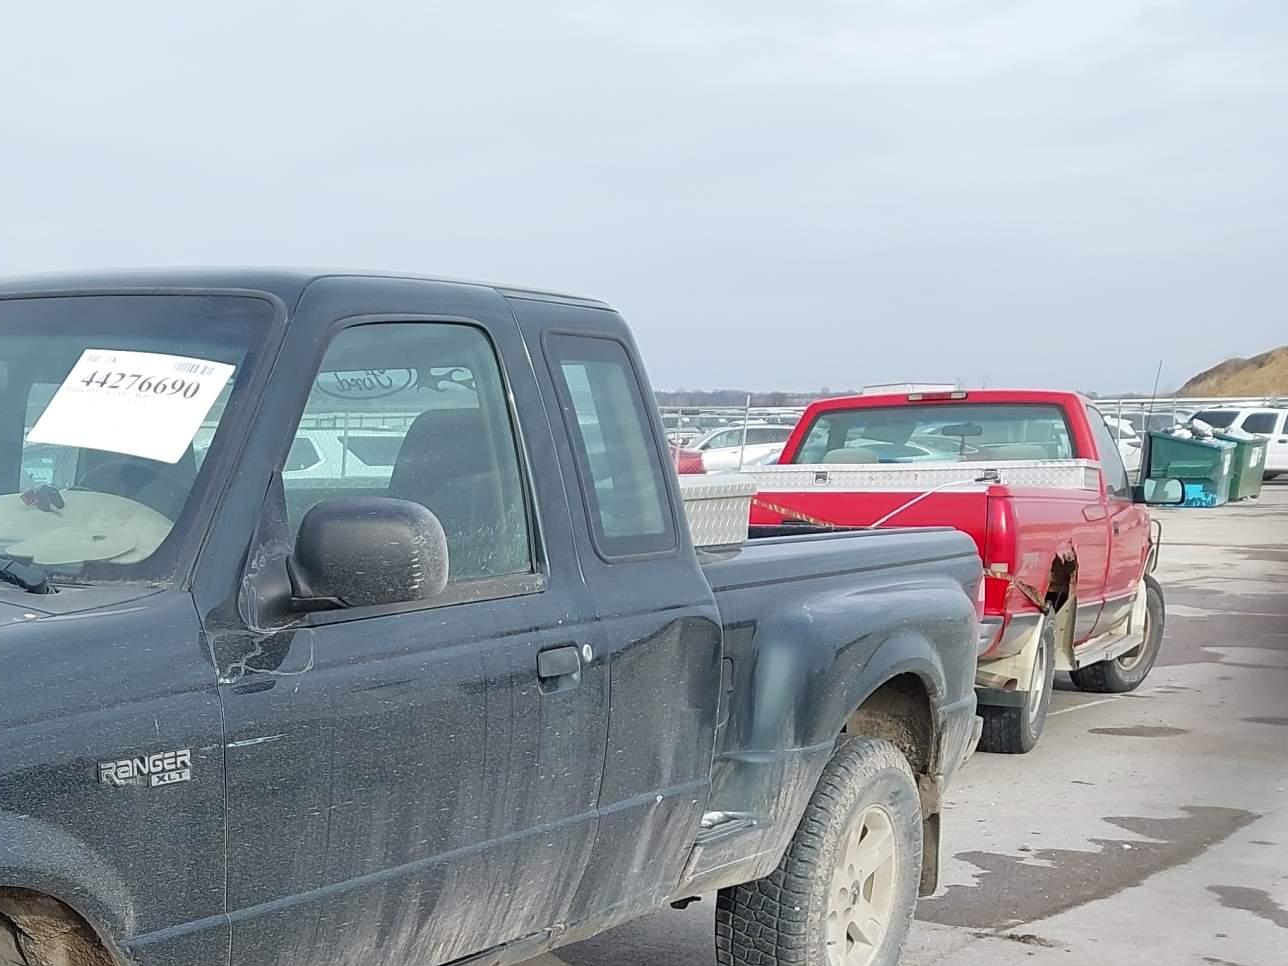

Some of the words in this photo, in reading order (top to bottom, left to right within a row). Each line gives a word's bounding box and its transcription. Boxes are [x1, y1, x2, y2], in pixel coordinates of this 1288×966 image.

[81, 371, 201, 399] 44276690
[98, 749, 192, 786] RANGER
[155, 771, 185, 783] XLT
